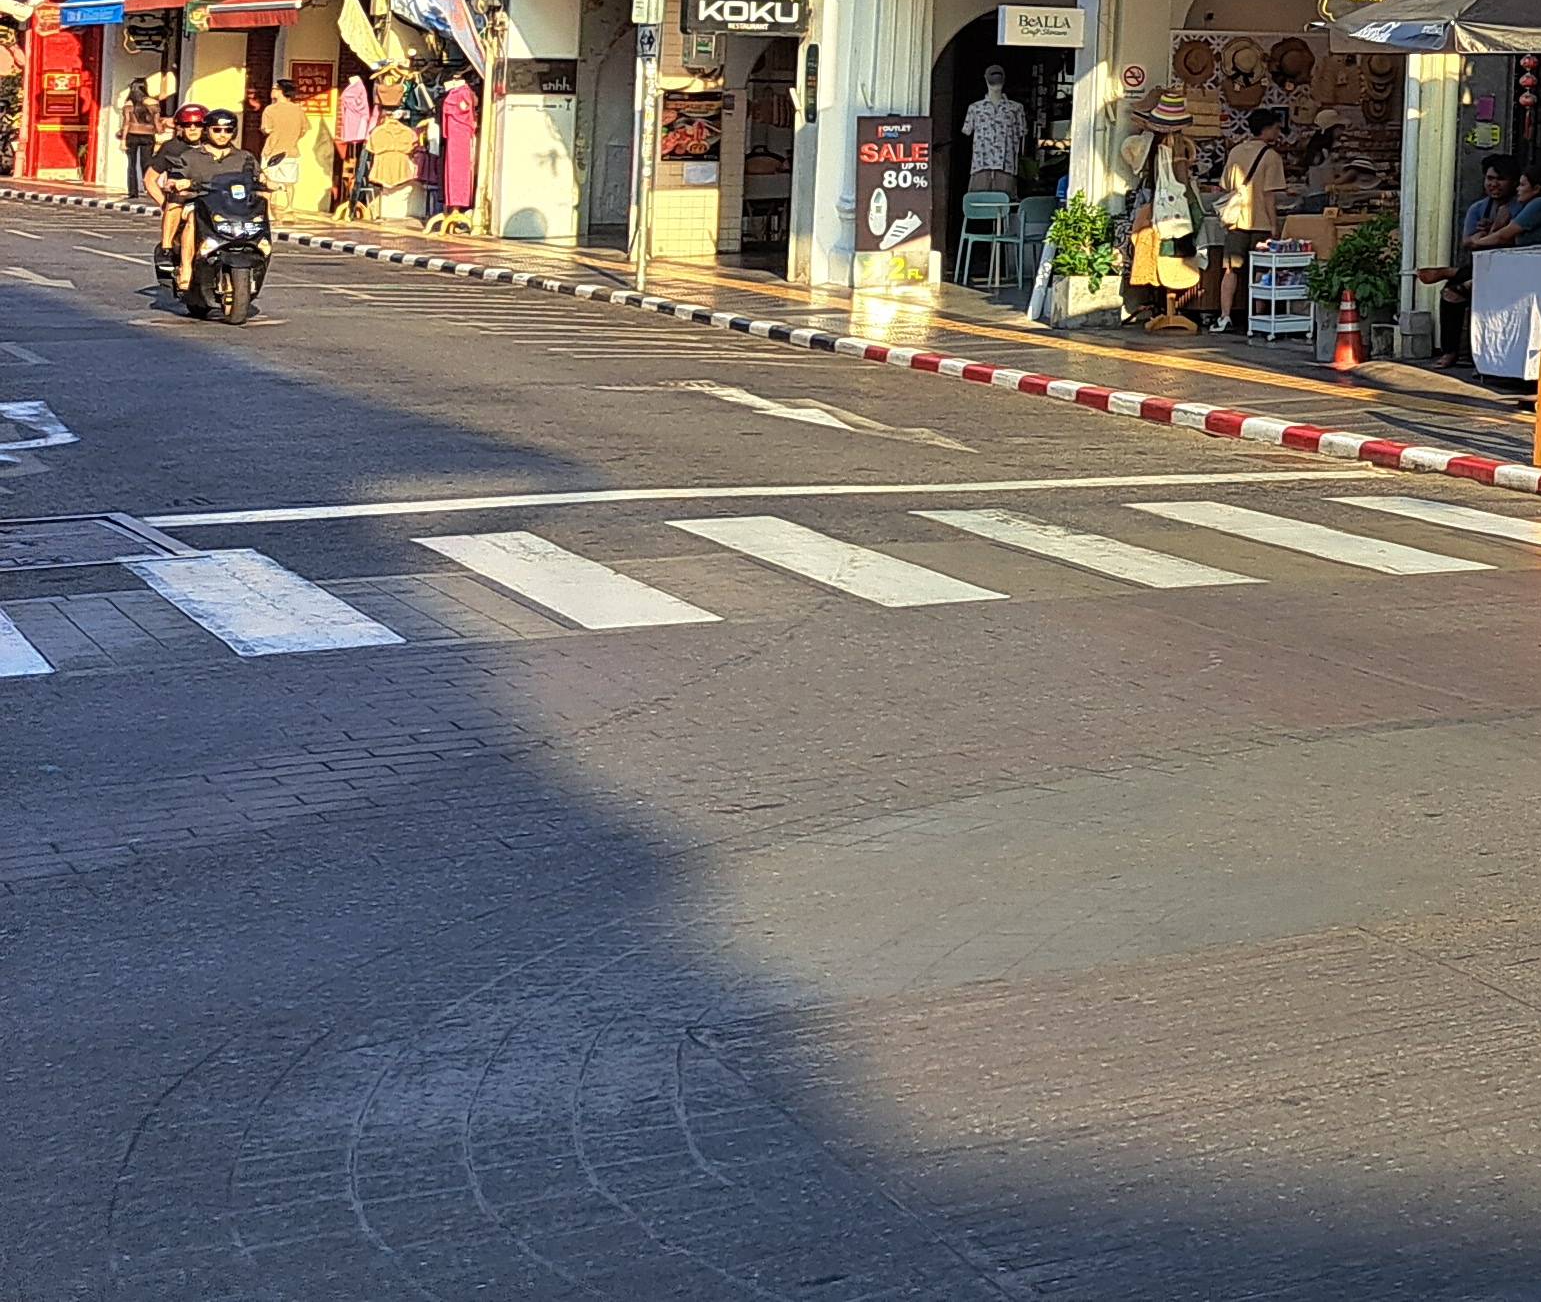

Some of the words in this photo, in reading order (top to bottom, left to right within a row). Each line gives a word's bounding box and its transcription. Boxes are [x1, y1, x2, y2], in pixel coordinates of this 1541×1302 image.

[699, 0, 799, 23] KOKU
[859, 142, 929, 163] SALE
[916, 162, 928, 170] TO
[883, 170, 928, 188] 80%
[888, 256, 905, 279] 2
